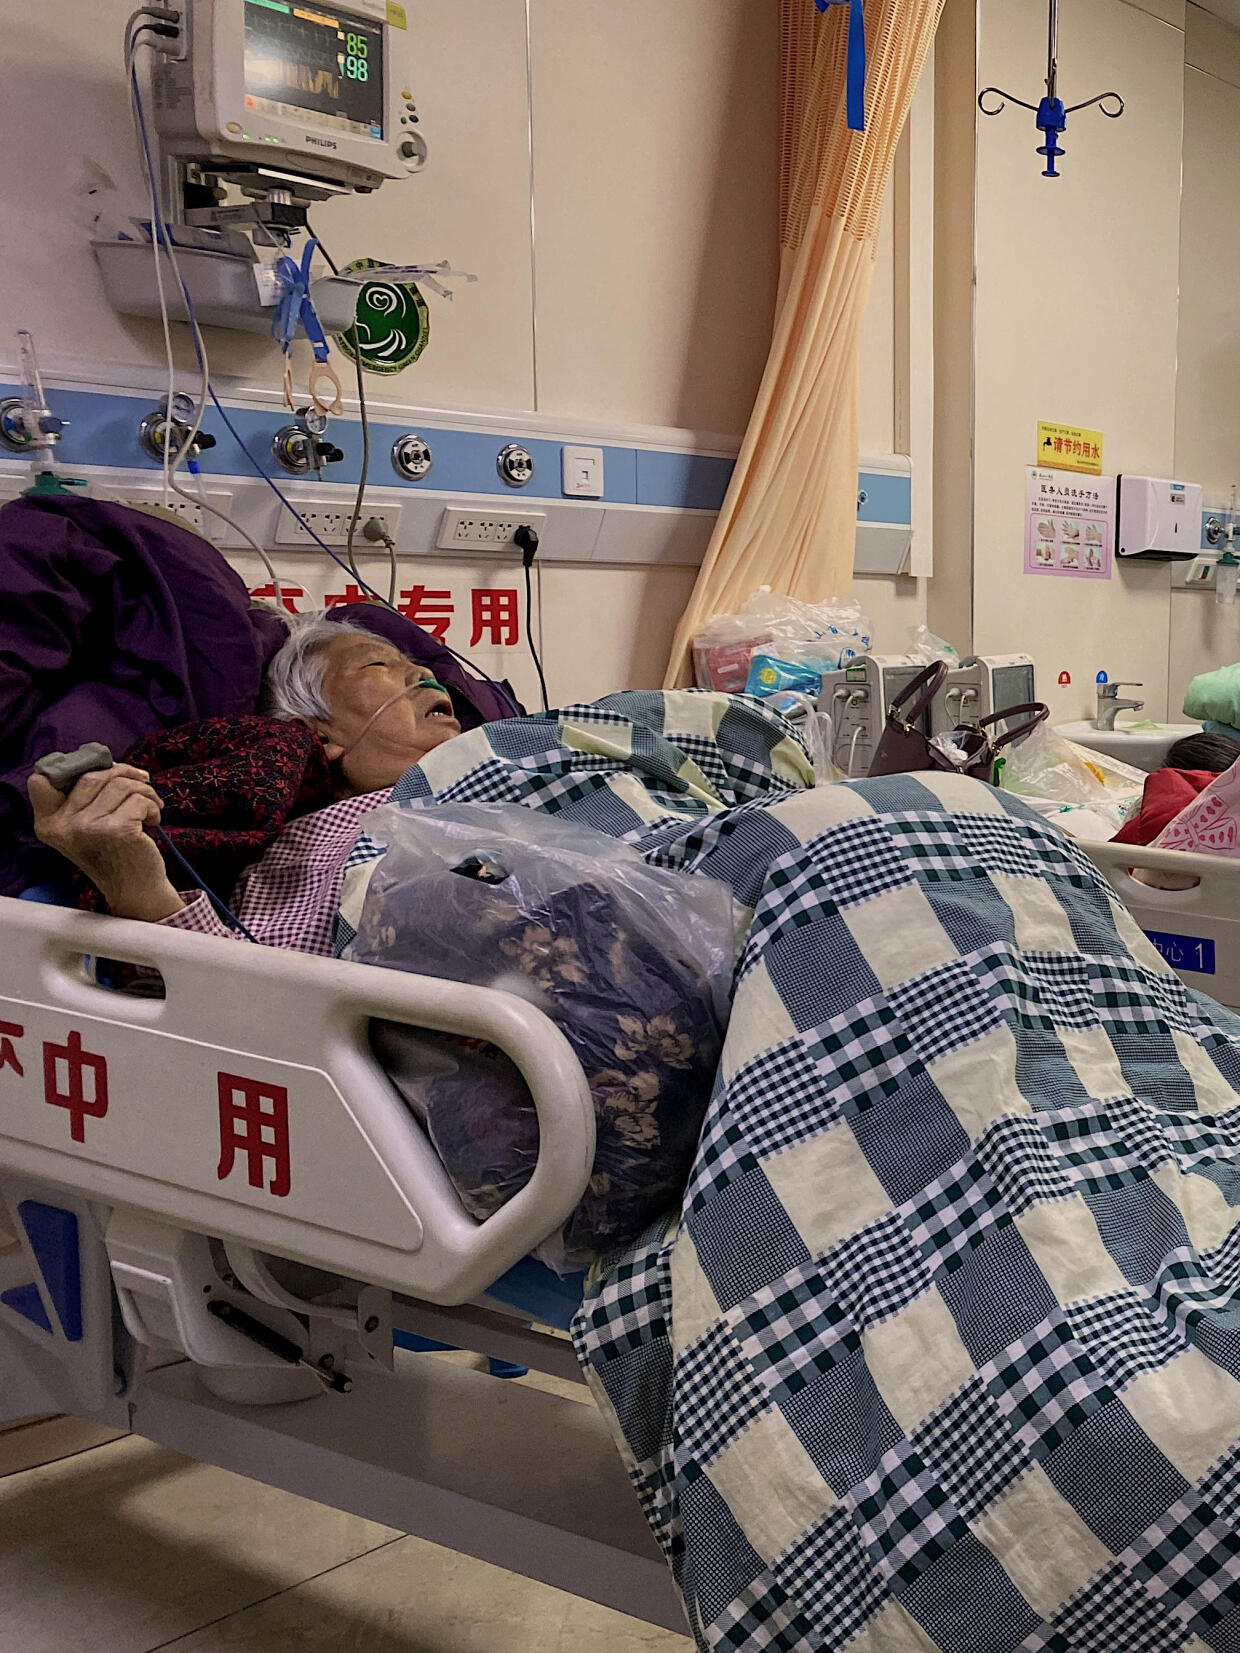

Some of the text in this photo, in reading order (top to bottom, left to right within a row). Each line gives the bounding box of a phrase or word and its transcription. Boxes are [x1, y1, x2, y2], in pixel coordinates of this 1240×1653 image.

[347, 33, 368, 59] 85
[346, 56, 368, 82] 98
[305, 136, 337, 149] PHILIPS
[1053, 436, 1100, 459] 请节约用水
[1041, 484, 1099, 500] 医务人员洗手方法
[1195, 942, 1203, 969] 1
[217, 1071, 291, 1197] 用
